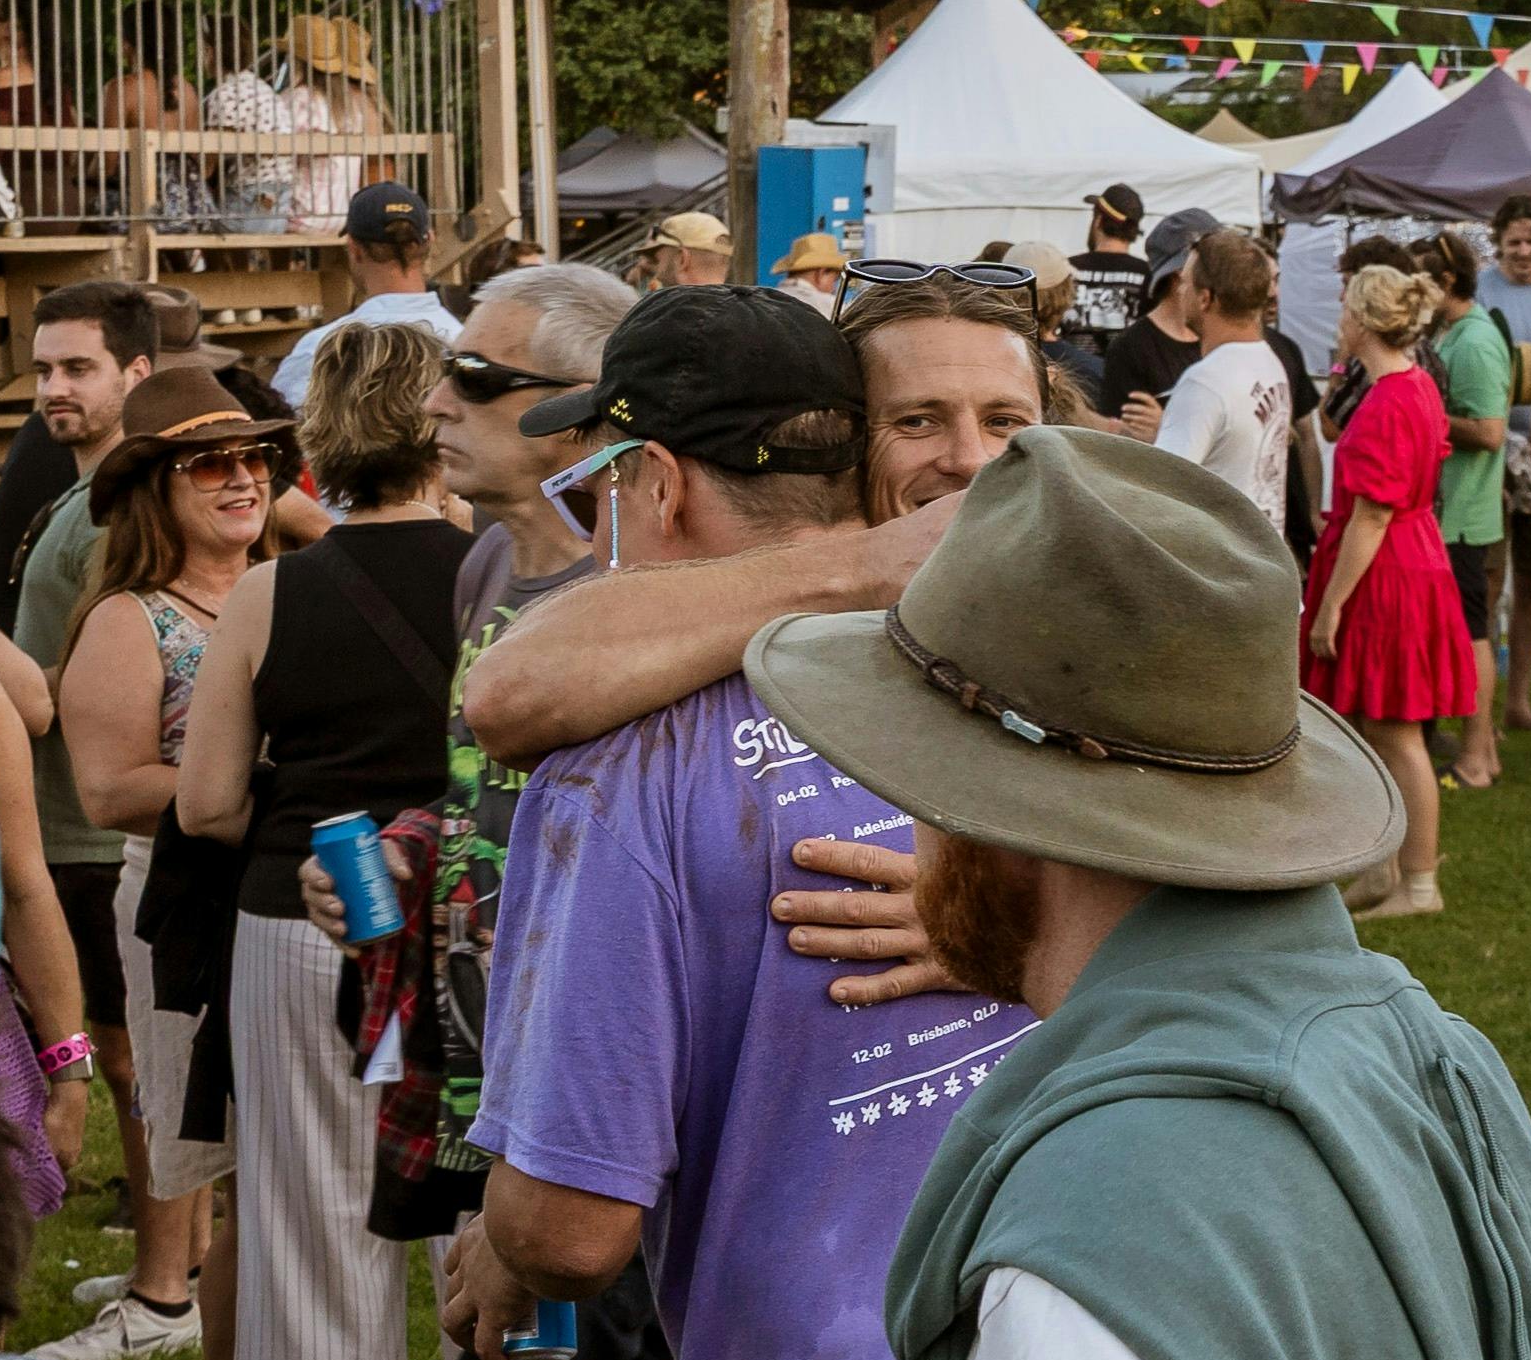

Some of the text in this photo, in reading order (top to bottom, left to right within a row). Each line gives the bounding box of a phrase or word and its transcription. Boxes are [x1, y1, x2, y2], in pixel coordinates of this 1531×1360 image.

[776, 783, 820, 807] 04-02
[852, 813, 915, 839] Adelaide
[851, 1001, 1001, 1065] 12-02 Brisbane, QLD
